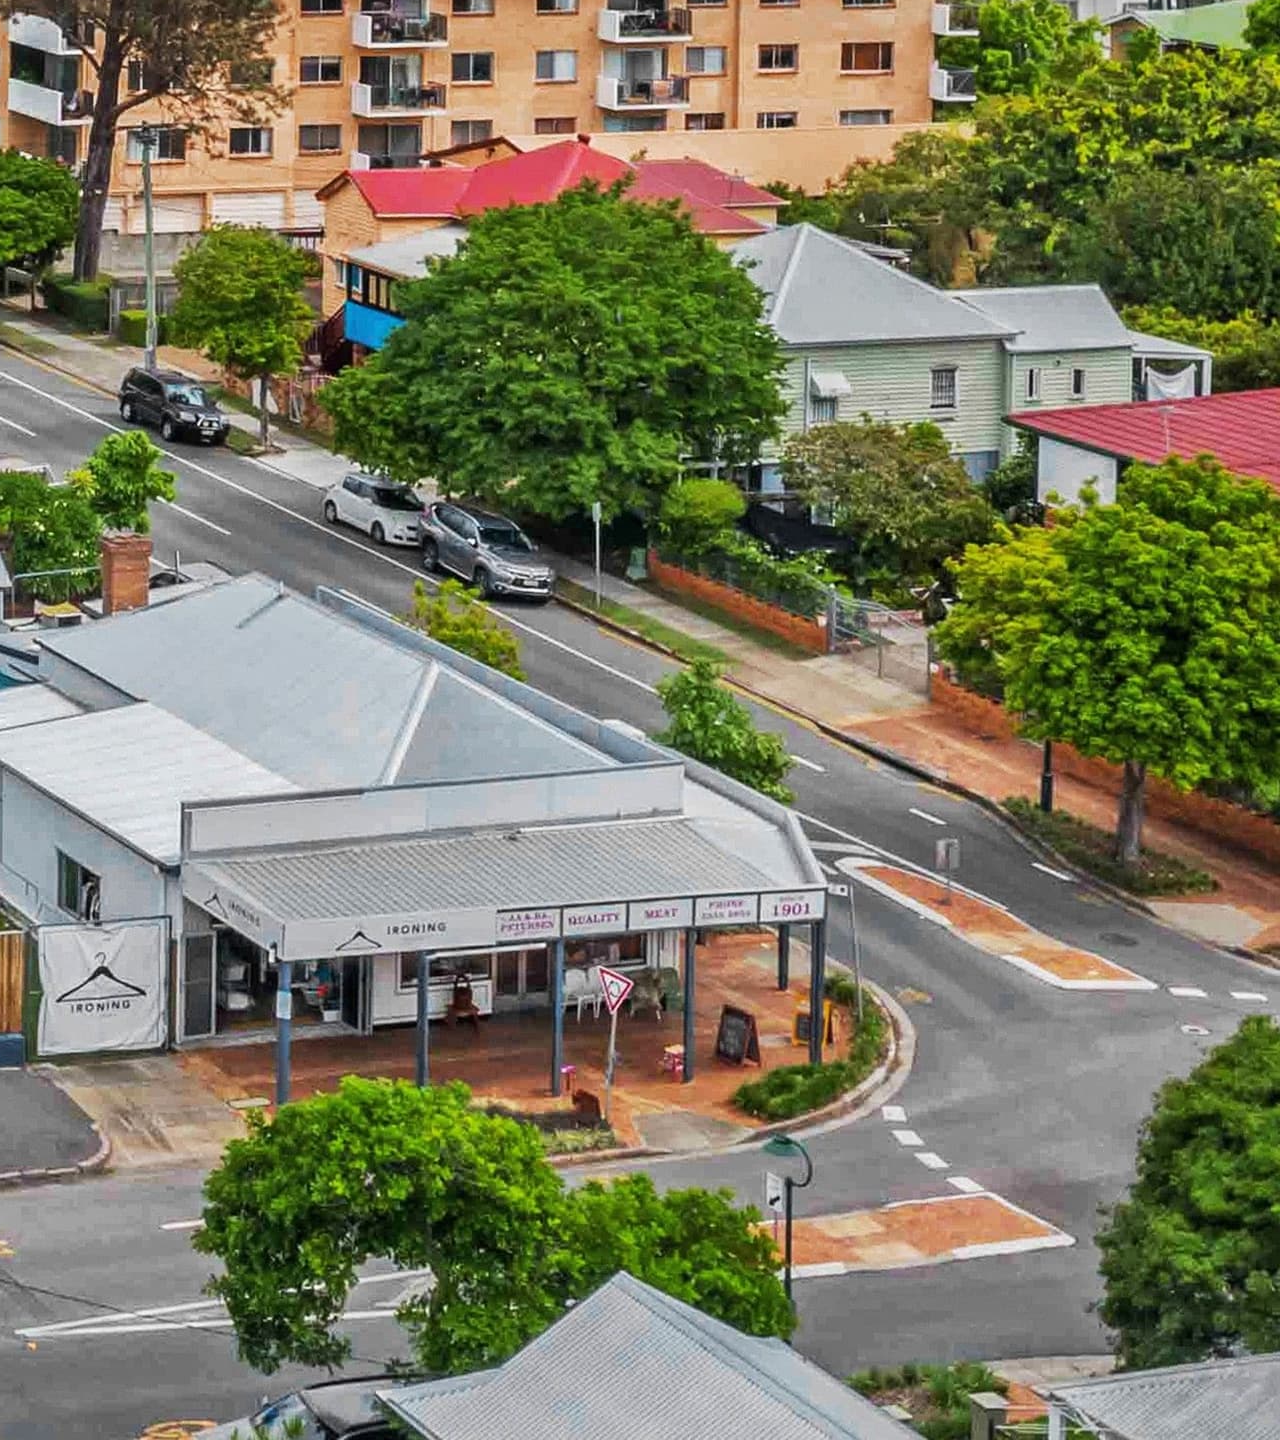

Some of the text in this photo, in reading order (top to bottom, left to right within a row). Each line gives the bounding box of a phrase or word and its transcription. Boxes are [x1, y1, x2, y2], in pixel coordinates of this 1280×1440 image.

[644, 908, 678, 920] MEAT
[774, 902, 810, 917] 1901
[568, 912, 620, 927] QUALITY
[387, 922, 447, 936] IRONING
[71, 1000, 131, 1014] IRONING
